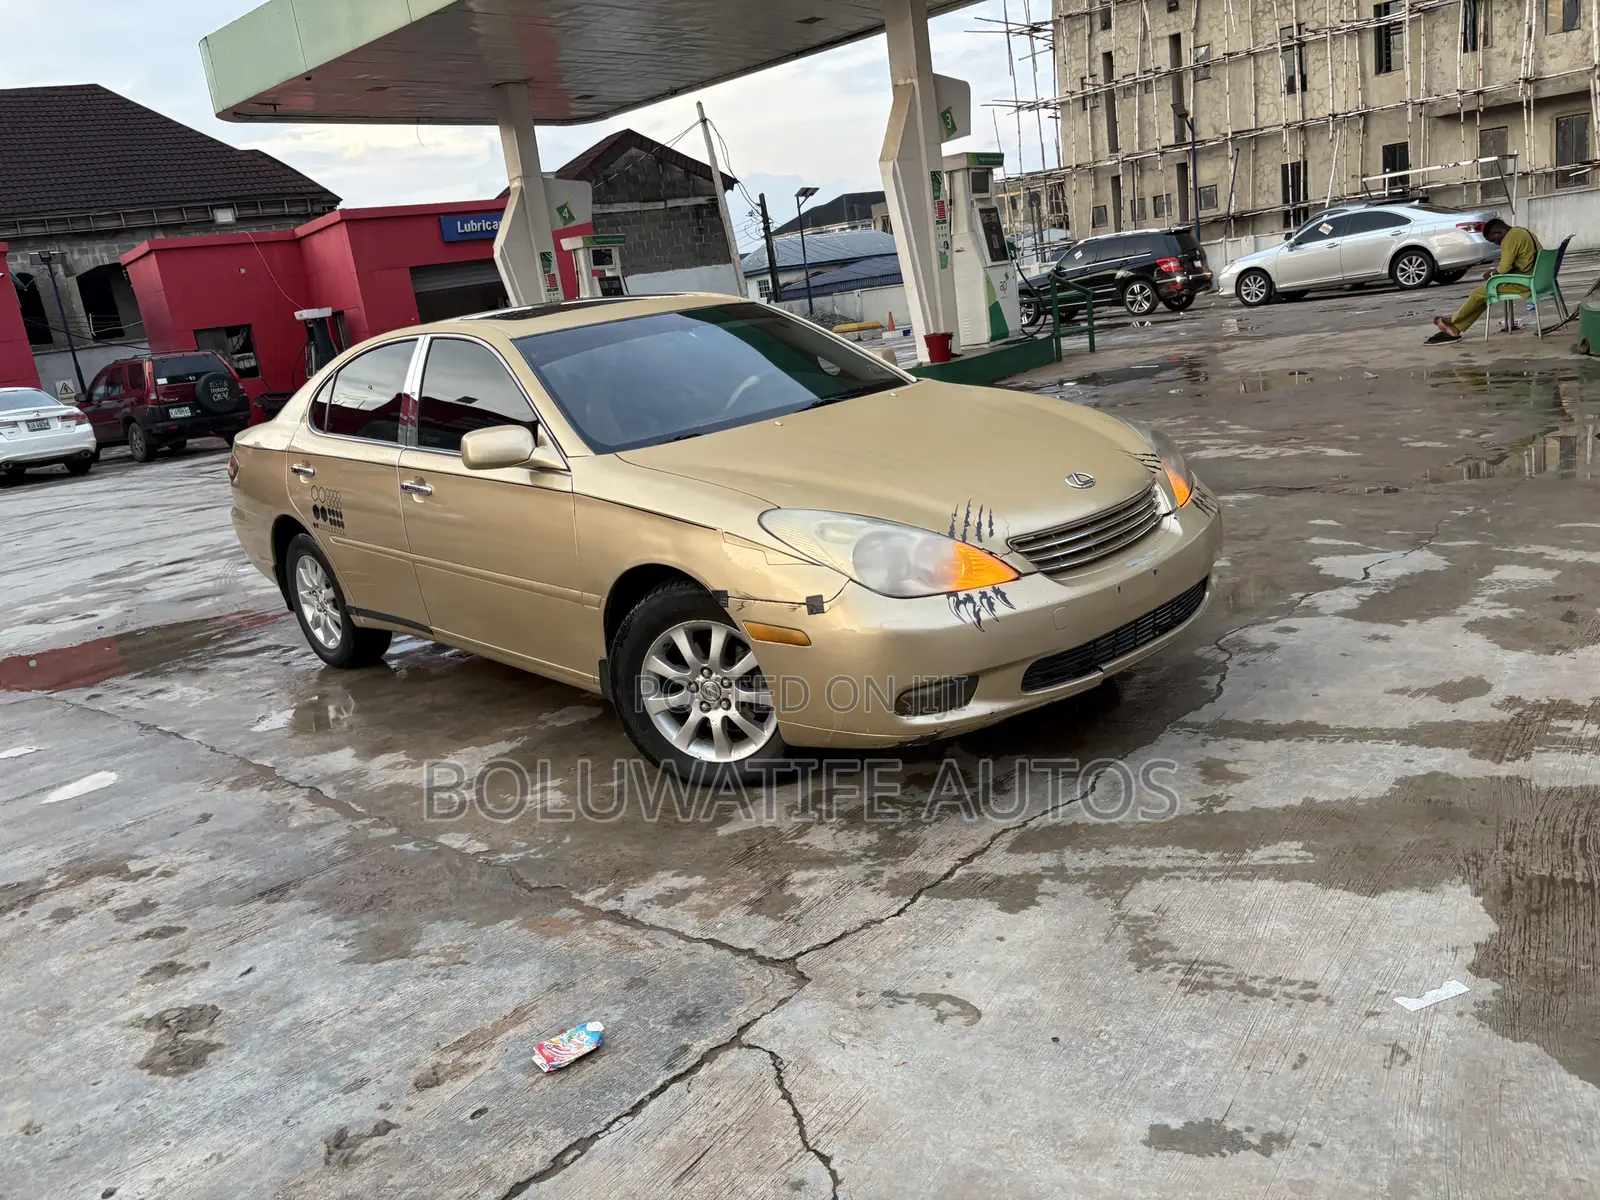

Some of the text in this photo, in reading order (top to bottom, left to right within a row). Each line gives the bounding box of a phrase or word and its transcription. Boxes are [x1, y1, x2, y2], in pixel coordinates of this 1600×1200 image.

[945, 113, 952, 129] 3
[562, 207, 569, 219] 4
[457, 219, 502, 233] Lubrica
